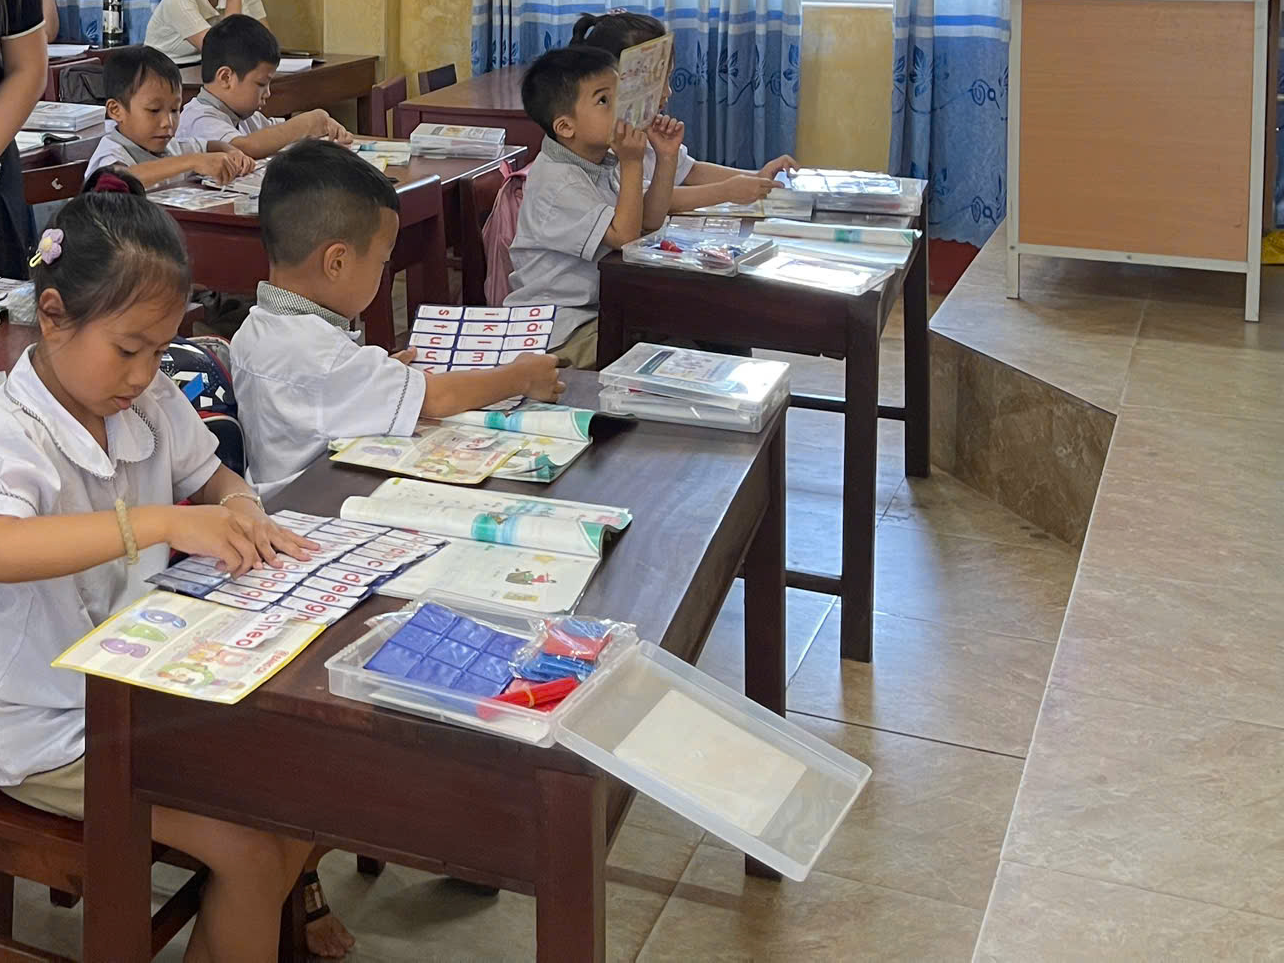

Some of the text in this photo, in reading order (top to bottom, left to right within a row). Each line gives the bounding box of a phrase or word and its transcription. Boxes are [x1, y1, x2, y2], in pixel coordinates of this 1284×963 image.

[529, 308, 541, 317] a
[482, 324, 498, 332] k
[429, 336, 442, 345] u
[471, 352, 484, 362] m
[332, 584, 348, 592] e
